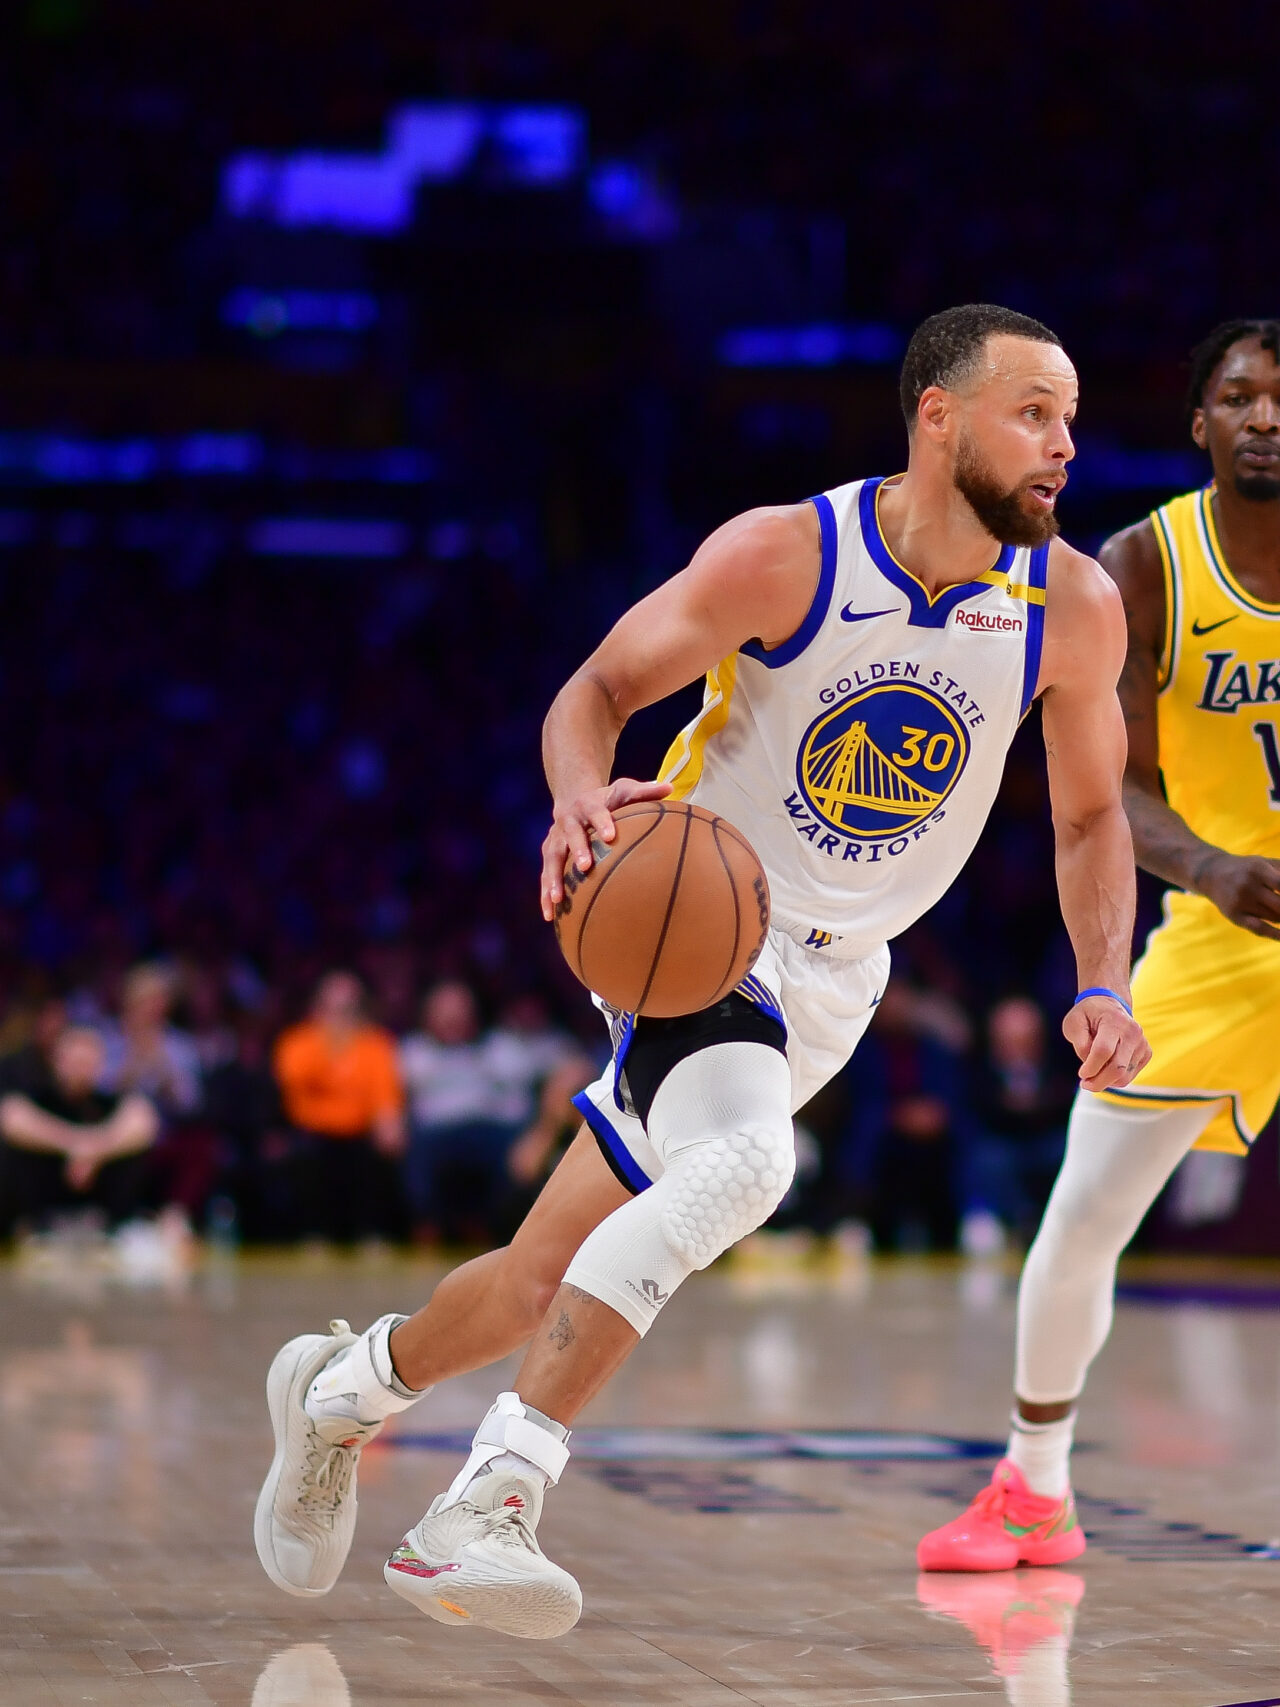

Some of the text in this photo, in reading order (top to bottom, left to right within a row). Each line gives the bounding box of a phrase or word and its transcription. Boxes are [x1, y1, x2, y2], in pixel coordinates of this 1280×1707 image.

[955, 609, 1023, 632] Rakuten
[819, 661, 986, 729] GOLDEN STATE
[892, 725, 955, 772] 30
[783, 790, 946, 863] WARRIORS
